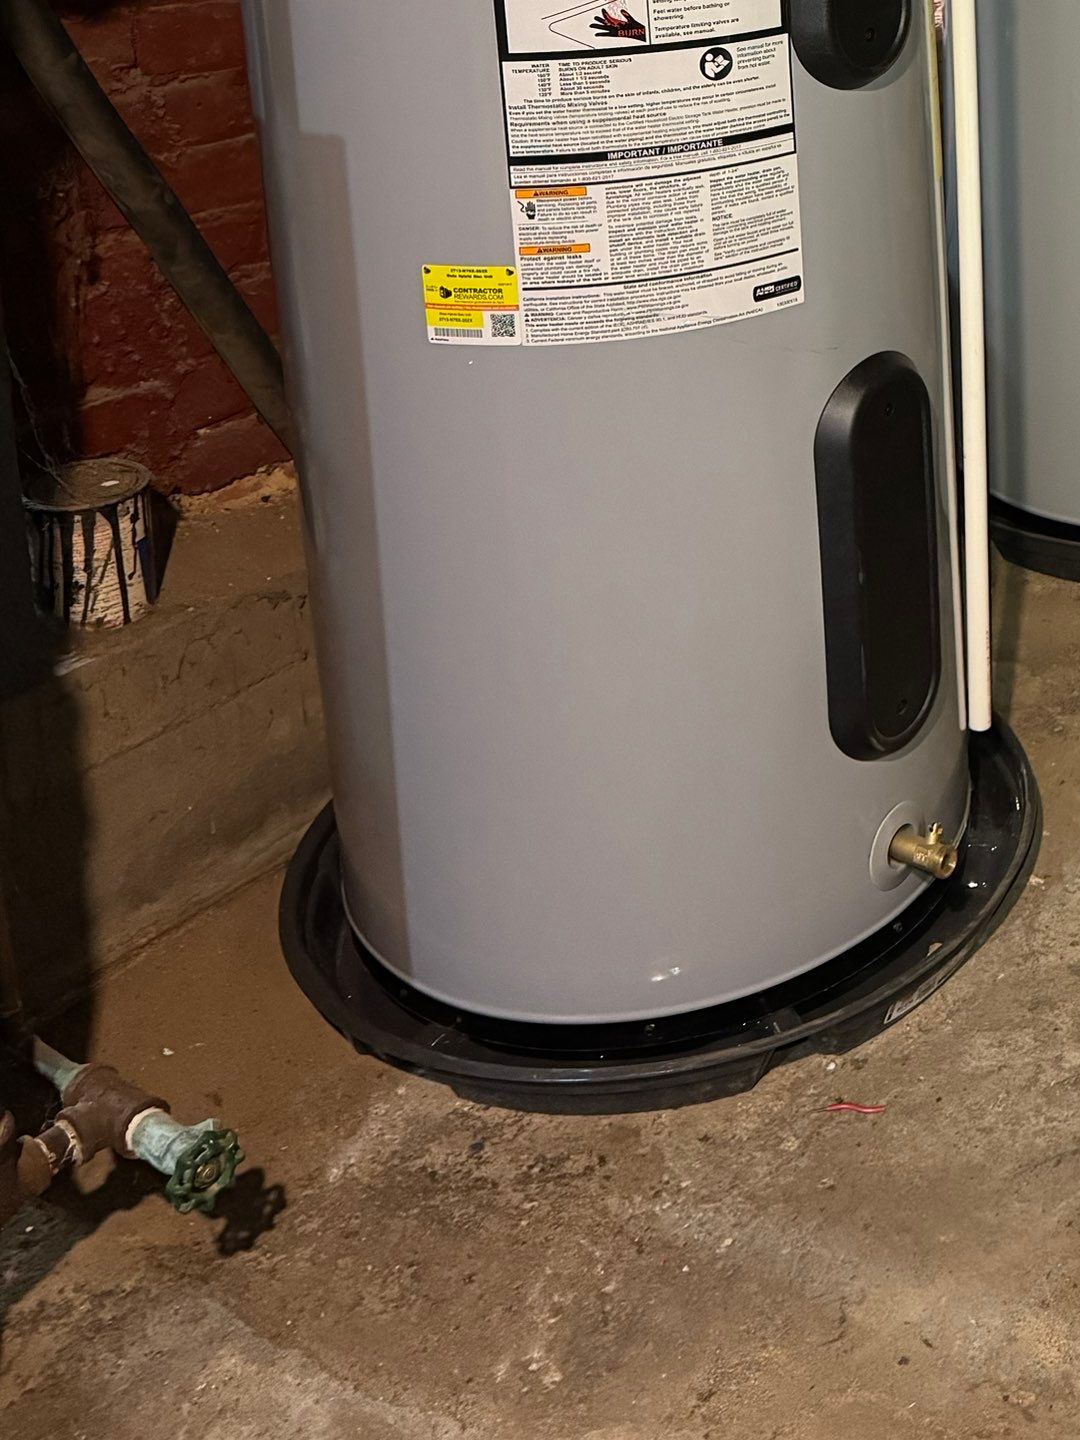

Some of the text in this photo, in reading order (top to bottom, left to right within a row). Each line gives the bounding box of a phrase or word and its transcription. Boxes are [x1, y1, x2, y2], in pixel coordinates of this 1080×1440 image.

[655, 24, 690, 32] Temperature
[618, 29, 645, 37] BURN
[607, 148, 660, 160] IMPORTANT
[667, 139, 724, 154] IMPORTANTE
